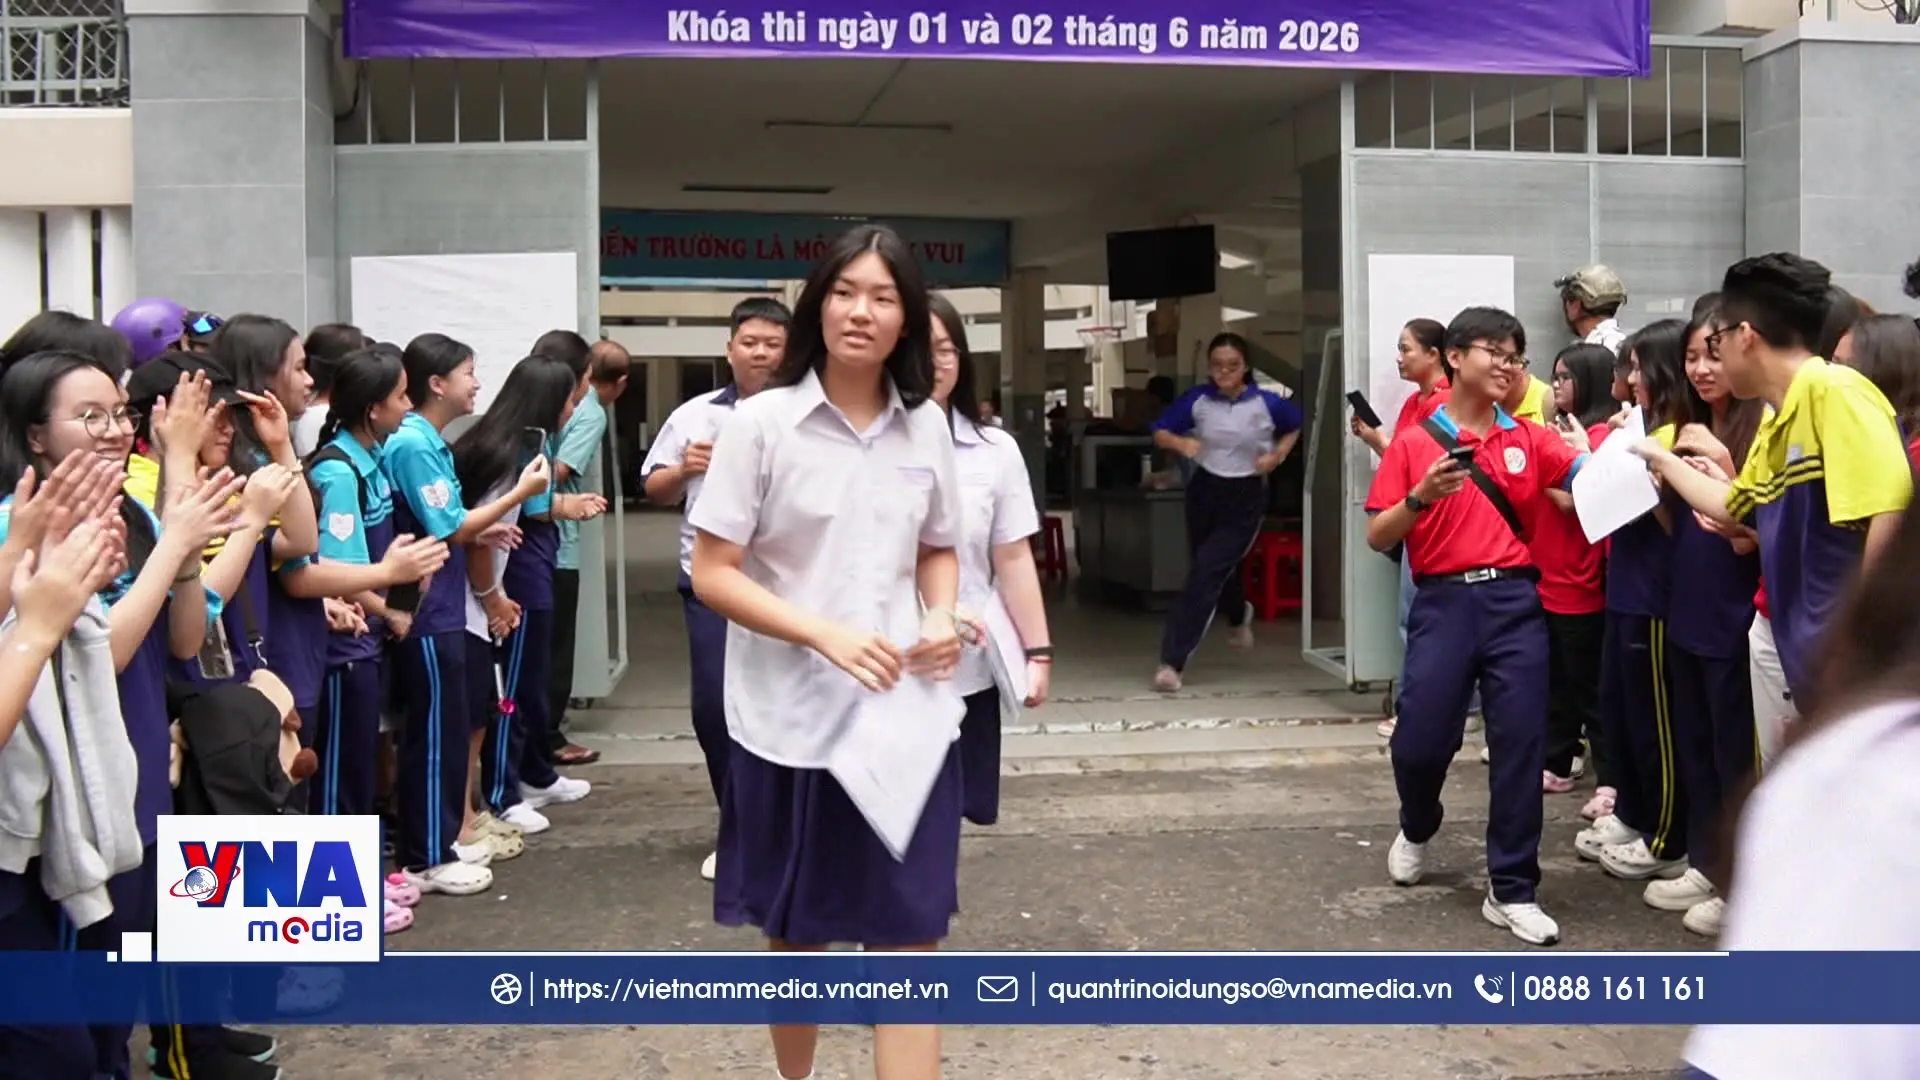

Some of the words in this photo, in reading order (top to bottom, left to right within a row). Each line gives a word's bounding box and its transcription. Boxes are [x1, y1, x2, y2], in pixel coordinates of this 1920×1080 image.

[668, 10, 751, 43] Khóa
[761, 11, 806, 43] thi
[818, 11, 898, 50] ngày
[909, 12, 947, 44] 01
[962, 13, 1000, 44] và
[1011, 14, 1053, 45] 02
[1064, 15, 1157, 53] tháng
[1169, 17, 1189, 48] 6
[1200, 18, 1267, 49] năm
[1279, 20, 1360, 52] 2026
[646, 231, 747, 260] TRƯỜNG
[755, 232, 785, 260] LÀ
[923, 242, 965, 265] VUI
